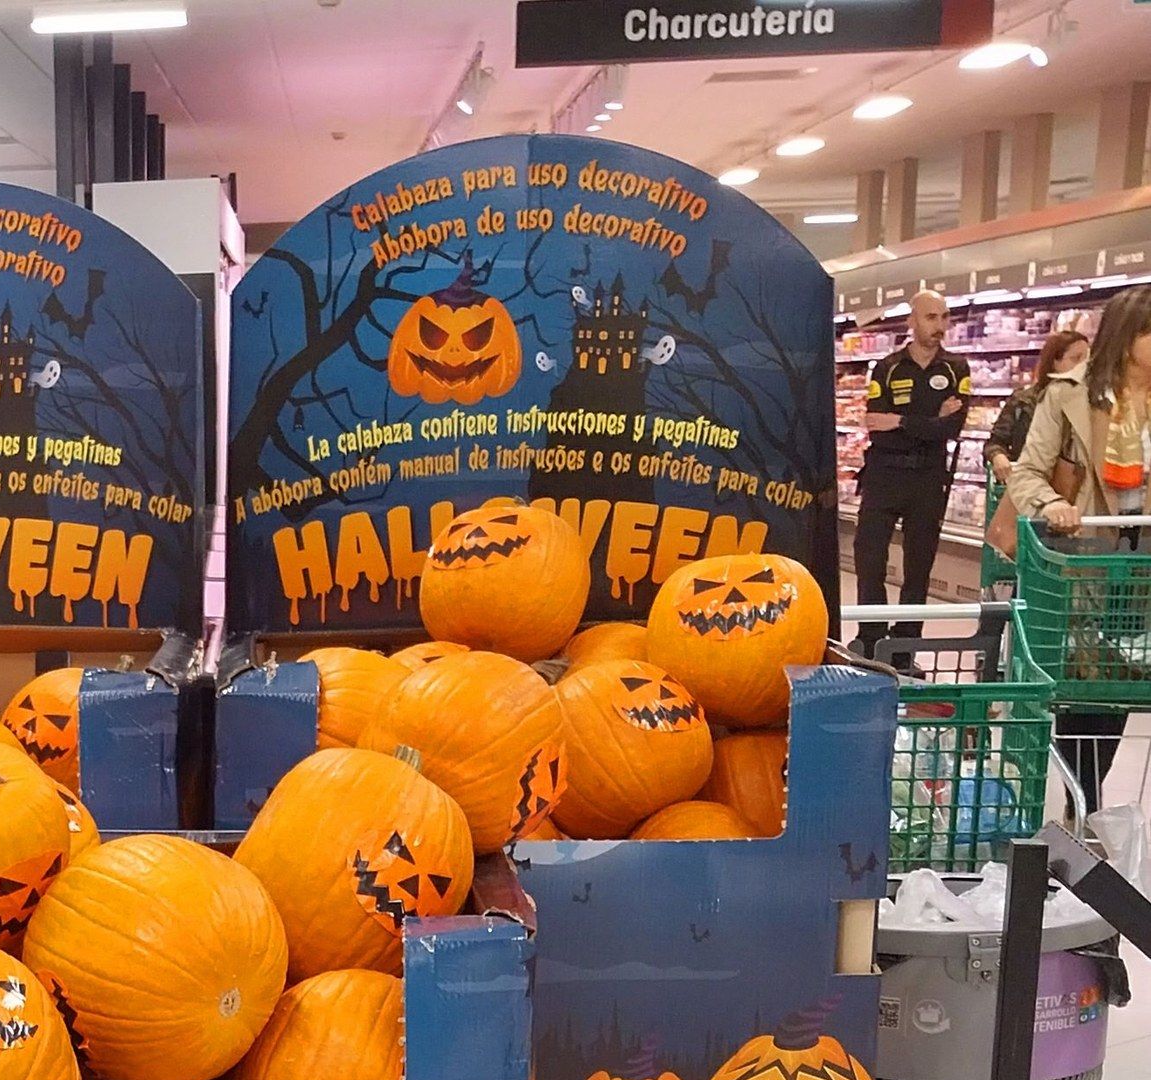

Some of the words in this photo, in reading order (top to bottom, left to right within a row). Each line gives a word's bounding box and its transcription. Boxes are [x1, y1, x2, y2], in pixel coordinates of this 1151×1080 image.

[624, 0, 834, 41] Charcutería
[351, 174, 453, 232] Calabaza
[462, 162, 517, 199] para
[528, 161, 569, 191] uso
[578, 159, 709, 222] decorativo
[370, 214, 467, 270] Abóbora
[477, 204, 505, 237] de
[516, 205, 554, 232] uso
[563, 203, 688, 258] decorativo
[27, 434, 38, 464] y
[44, 434, 122, 468] pegatinas
[307, 435, 330, 462] La
[337, 420, 413, 454] calabaza
[421, 408, 498, 443] contiene
[507, 405, 626, 438] instrucciones
[633, 414, 646, 443] y
[652, 415, 740, 450] pegatinas
[8, 469, 26, 494] os
[33, 468, 99, 503] enfeites
[105, 482, 143, 511] para
[148, 493, 193, 524] colar
[235, 497, 248, 524] A
[251, 476, 323, 516] abóbora
[329, 456, 392, 492] contém
[399, 447, 461, 480] manual
[468, 443, 489, 471] de
[496, 440, 585, 474] instruções
[592, 450, 603, 473] e
[611, 451, 632, 475] os
[638, 451, 711, 487] enfeites
[717, 467, 758, 496] para
[765, 480, 814, 511] colar
[1034, 1017, 1076, 1033] TENIBLE
